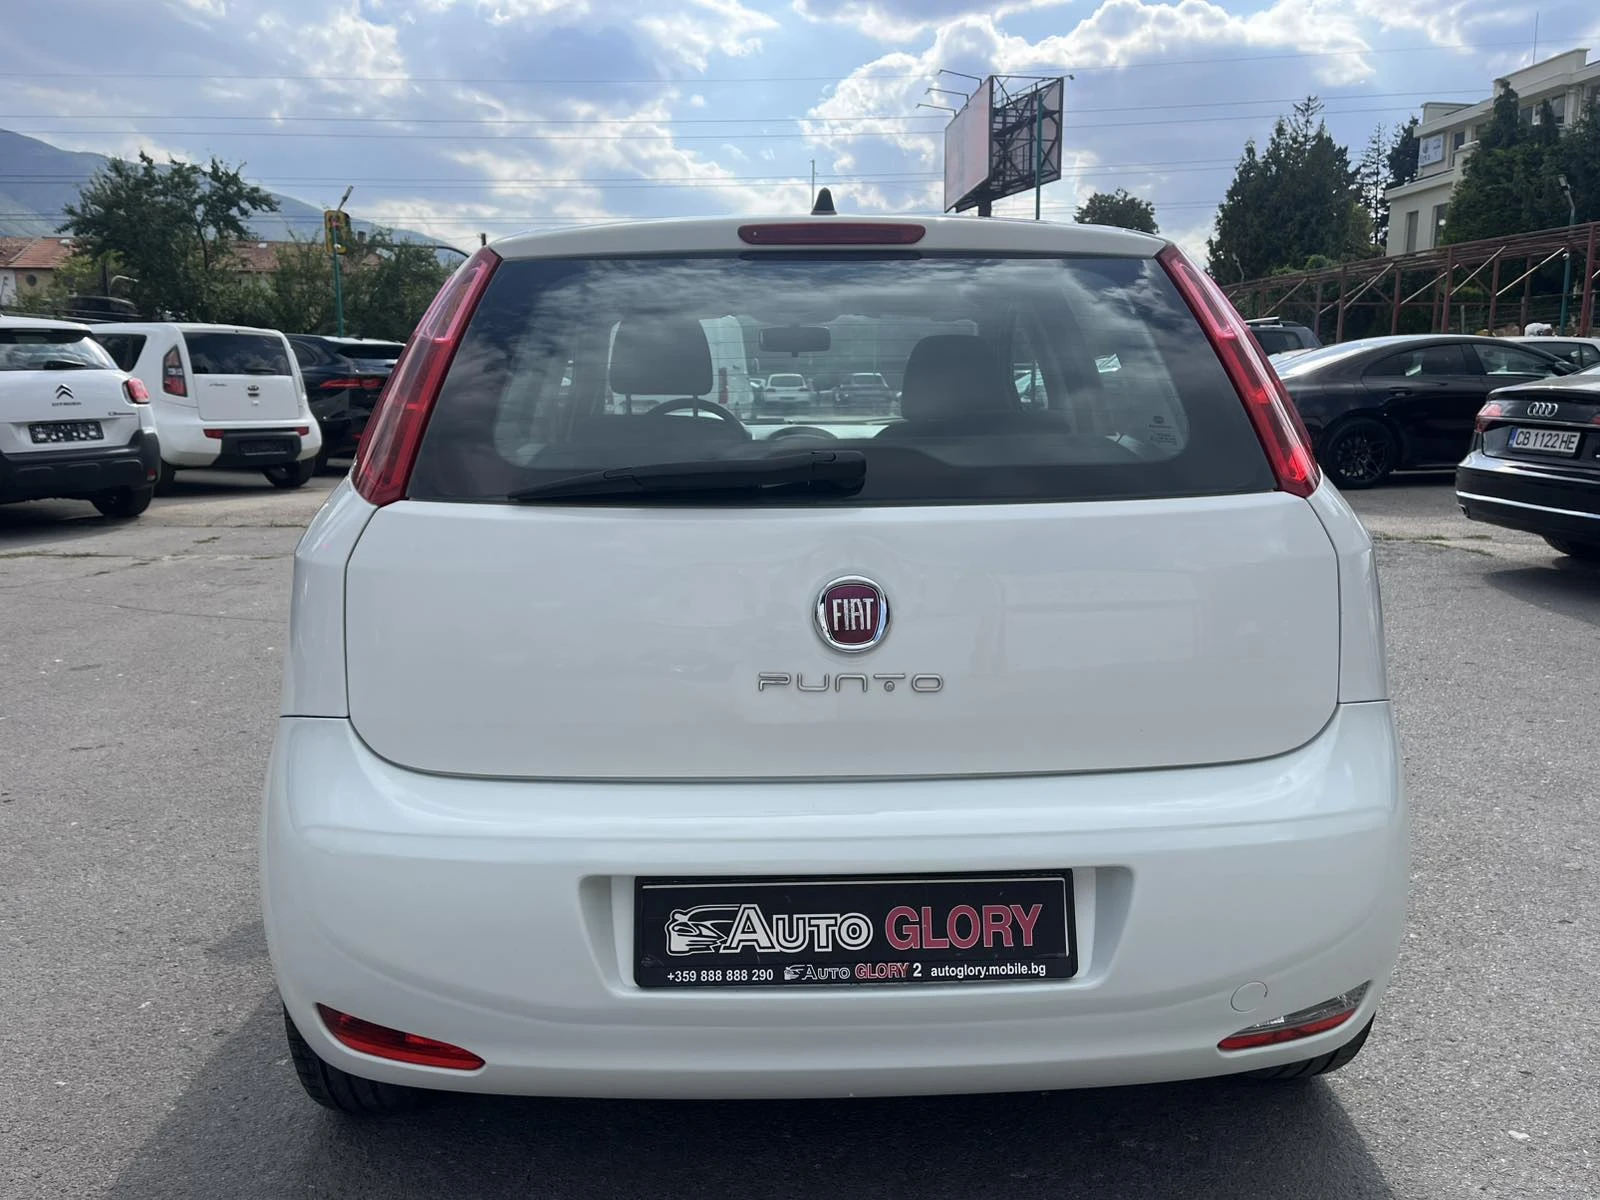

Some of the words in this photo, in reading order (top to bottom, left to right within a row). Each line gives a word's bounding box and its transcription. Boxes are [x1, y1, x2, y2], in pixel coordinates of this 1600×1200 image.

[1515, 430, 1531, 446] CB
[1533, 431, 1559, 449] 1122
[832, 598, 874, 631] FIAT
[758, 671, 944, 693] PUNTO
[885, 904, 1043, 950] GLORY
[667, 971, 697, 982] +359
[700, 970, 722, 982] 888
[726, 970, 748, 981] 888
[751, 969, 774, 981] 290
[855, 962, 909, 979] GLORY
[913, 963, 922, 977] 2
[931, 963, 1046, 979] autoglory.mobile.bg
